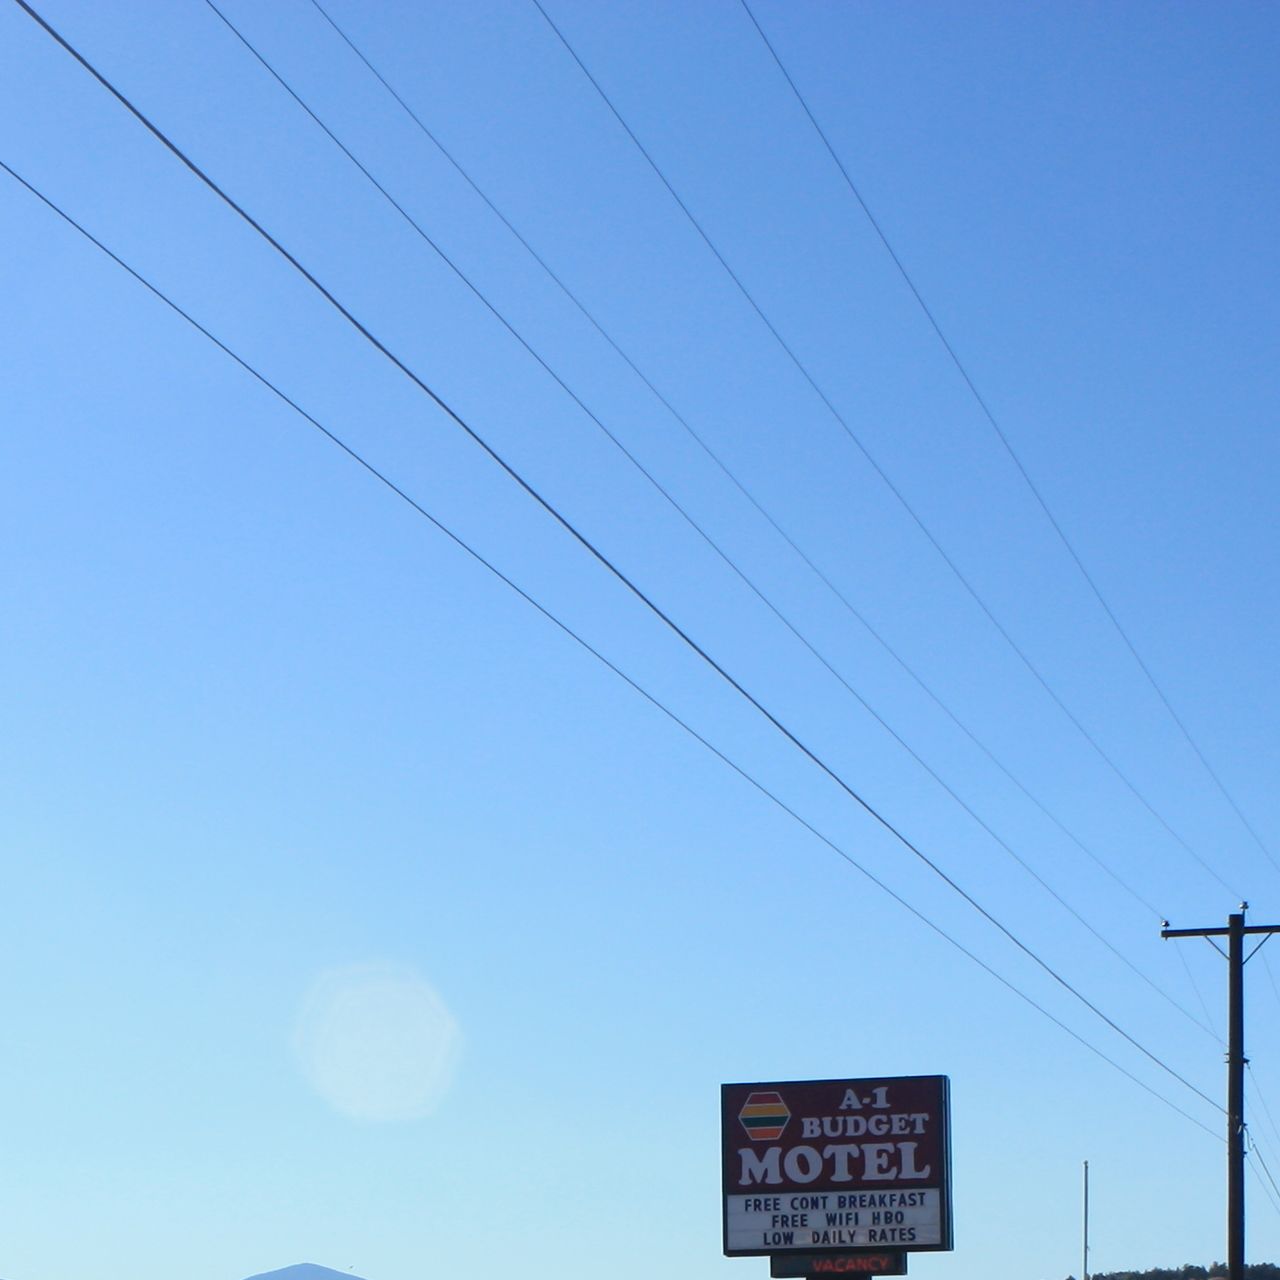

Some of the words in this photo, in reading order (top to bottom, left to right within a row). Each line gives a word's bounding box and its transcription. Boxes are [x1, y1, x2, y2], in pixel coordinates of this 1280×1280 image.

[839, 1087, 891, 1110] A-1
[801, 1113, 930, 1138] BUDGET
[738, 1142, 931, 1186] MOTEL
[744, 1197, 781, 1212] FREE
[790, 1196, 829, 1210] CONT
[837, 1192, 926, 1209] BREAKFAST
[772, 1214, 809, 1228] FREE
[825, 1212, 859, 1226] WIFI
[872, 1211, 905, 1225] HBO
[763, 1231, 795, 1246] LOW
[811, 1229, 857, 1244] DAILY
[868, 1228, 917, 1242] RATES
[812, 1255, 889, 1273] VACANCY
